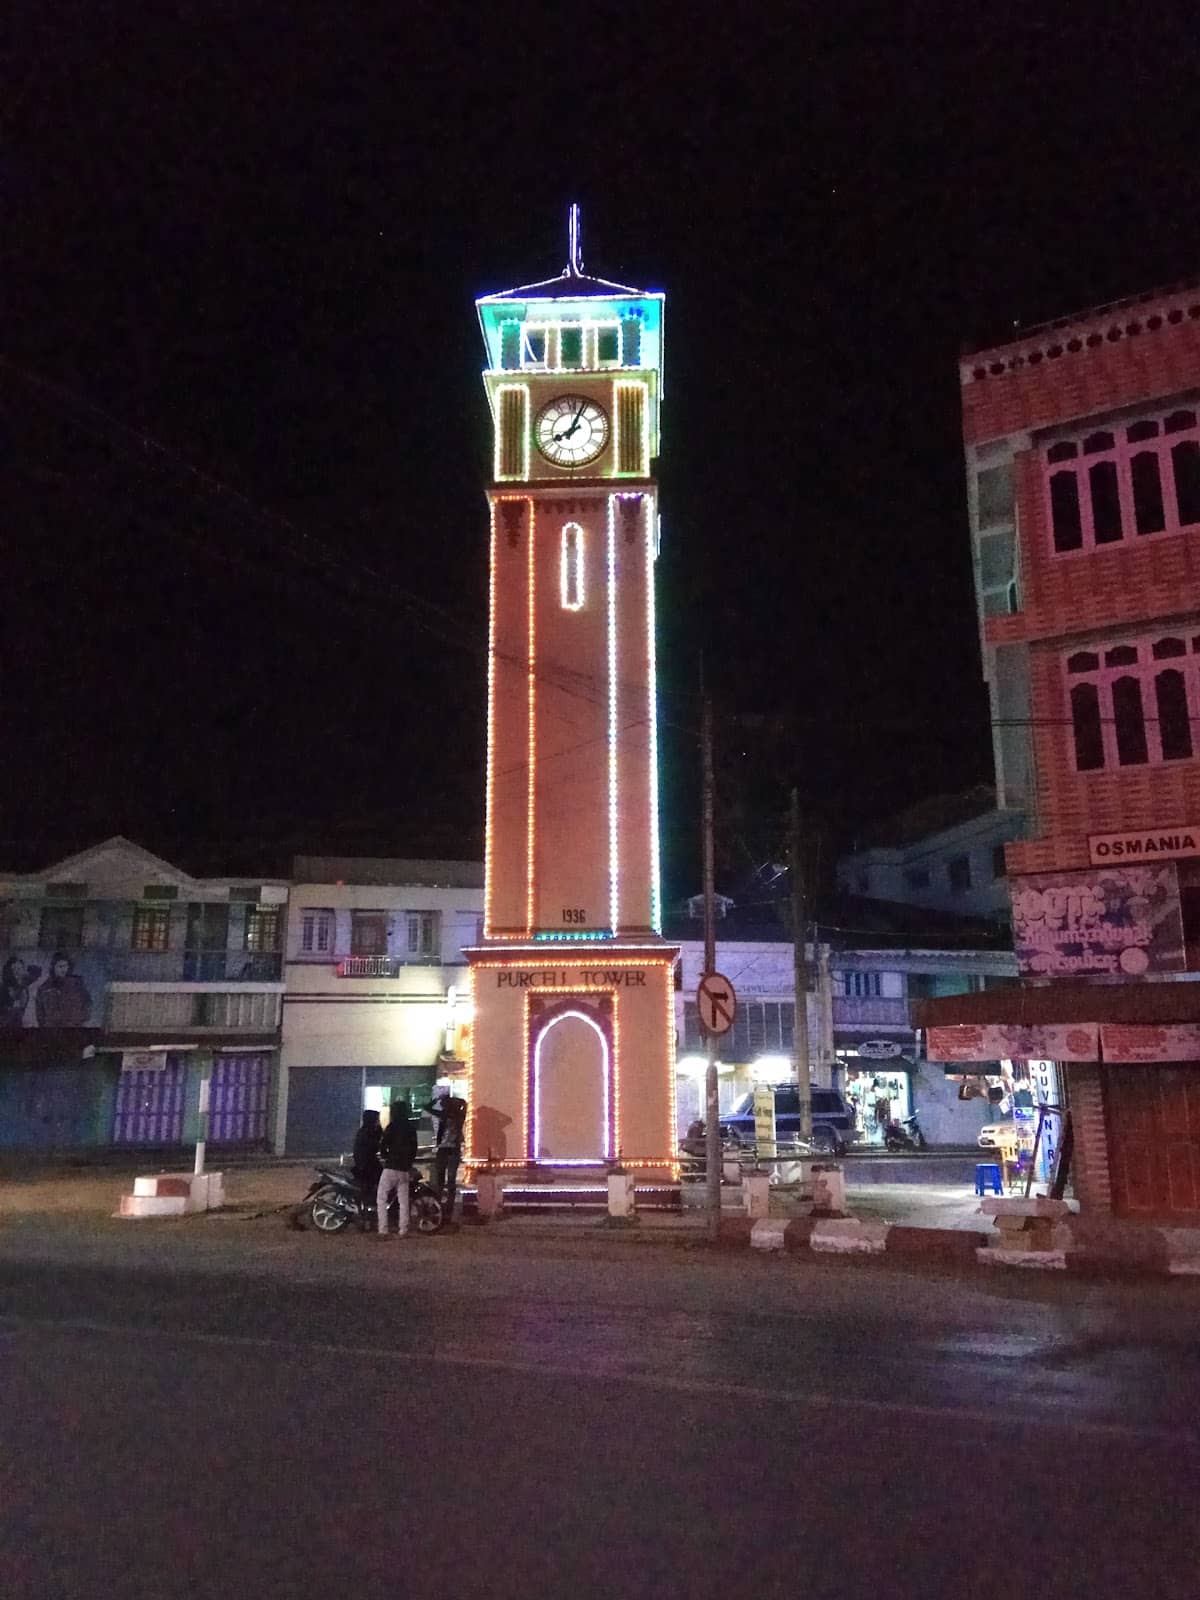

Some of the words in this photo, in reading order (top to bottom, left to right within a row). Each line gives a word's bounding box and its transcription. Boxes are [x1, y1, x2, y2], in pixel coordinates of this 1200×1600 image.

[1096, 834, 1196, 856] OSMANIA
[563, 909, 586, 925] 1936
[580, 970, 647, 987] TOWER
